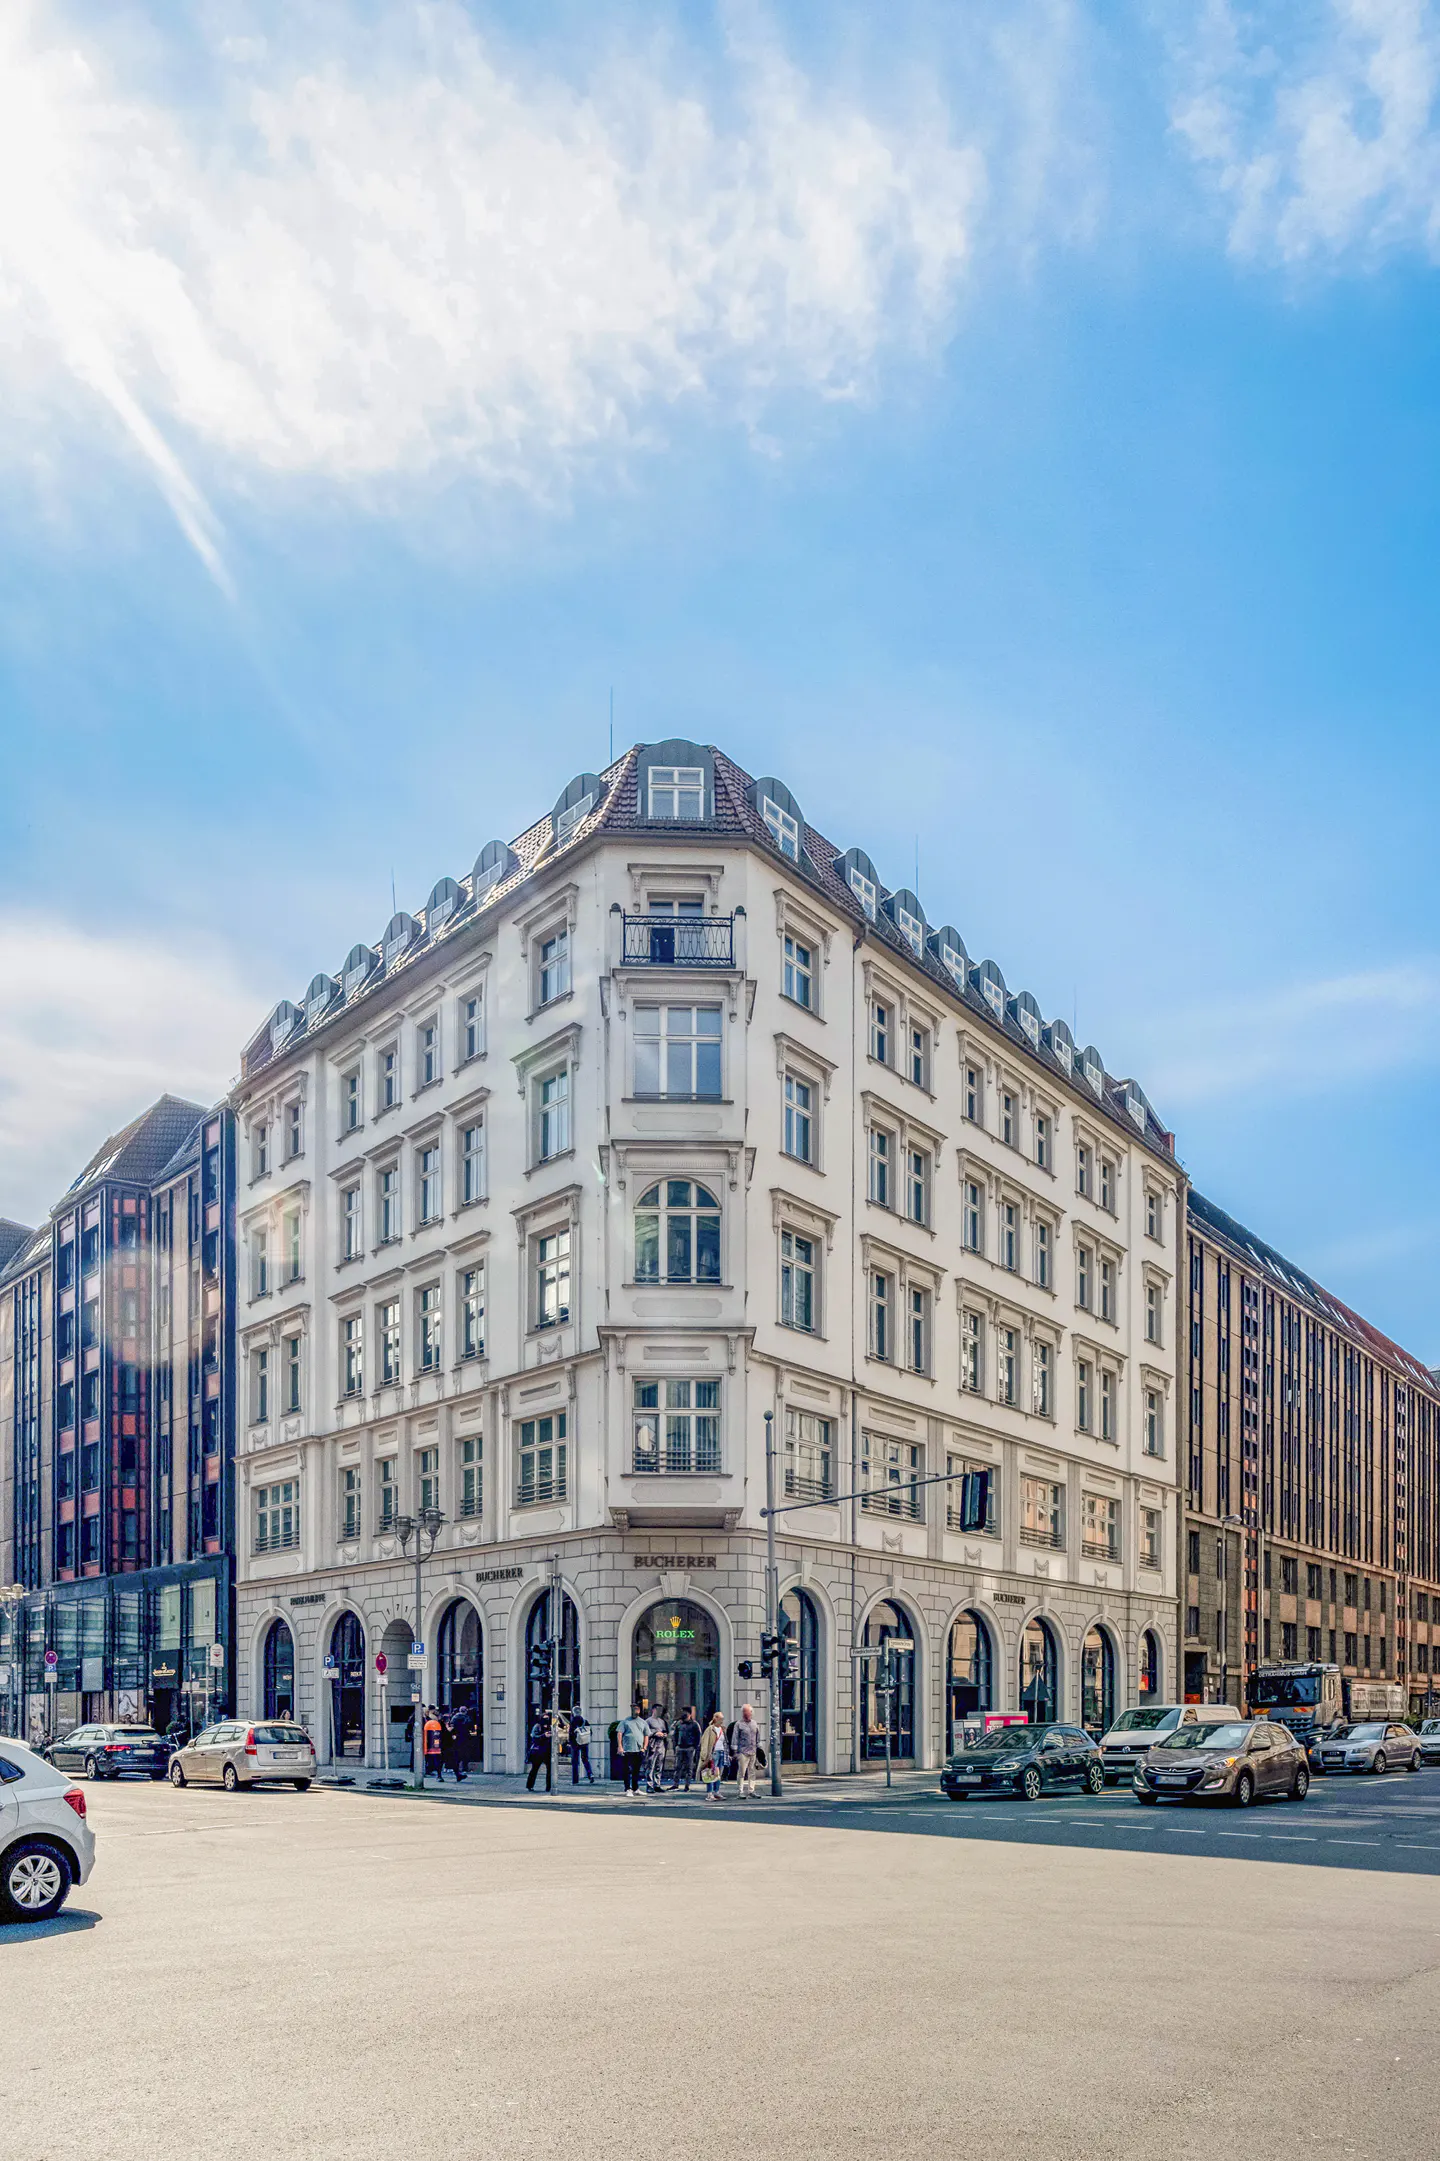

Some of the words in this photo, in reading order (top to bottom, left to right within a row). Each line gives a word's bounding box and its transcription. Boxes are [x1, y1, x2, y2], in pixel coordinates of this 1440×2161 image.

[633, 1556, 717, 1568] BUCHERER
[475, 1567, 524, 1583] BUCHERER
[993, 1593, 1026, 1605] BUCHERER
[655, 1630, 695, 1639] ROLEX
